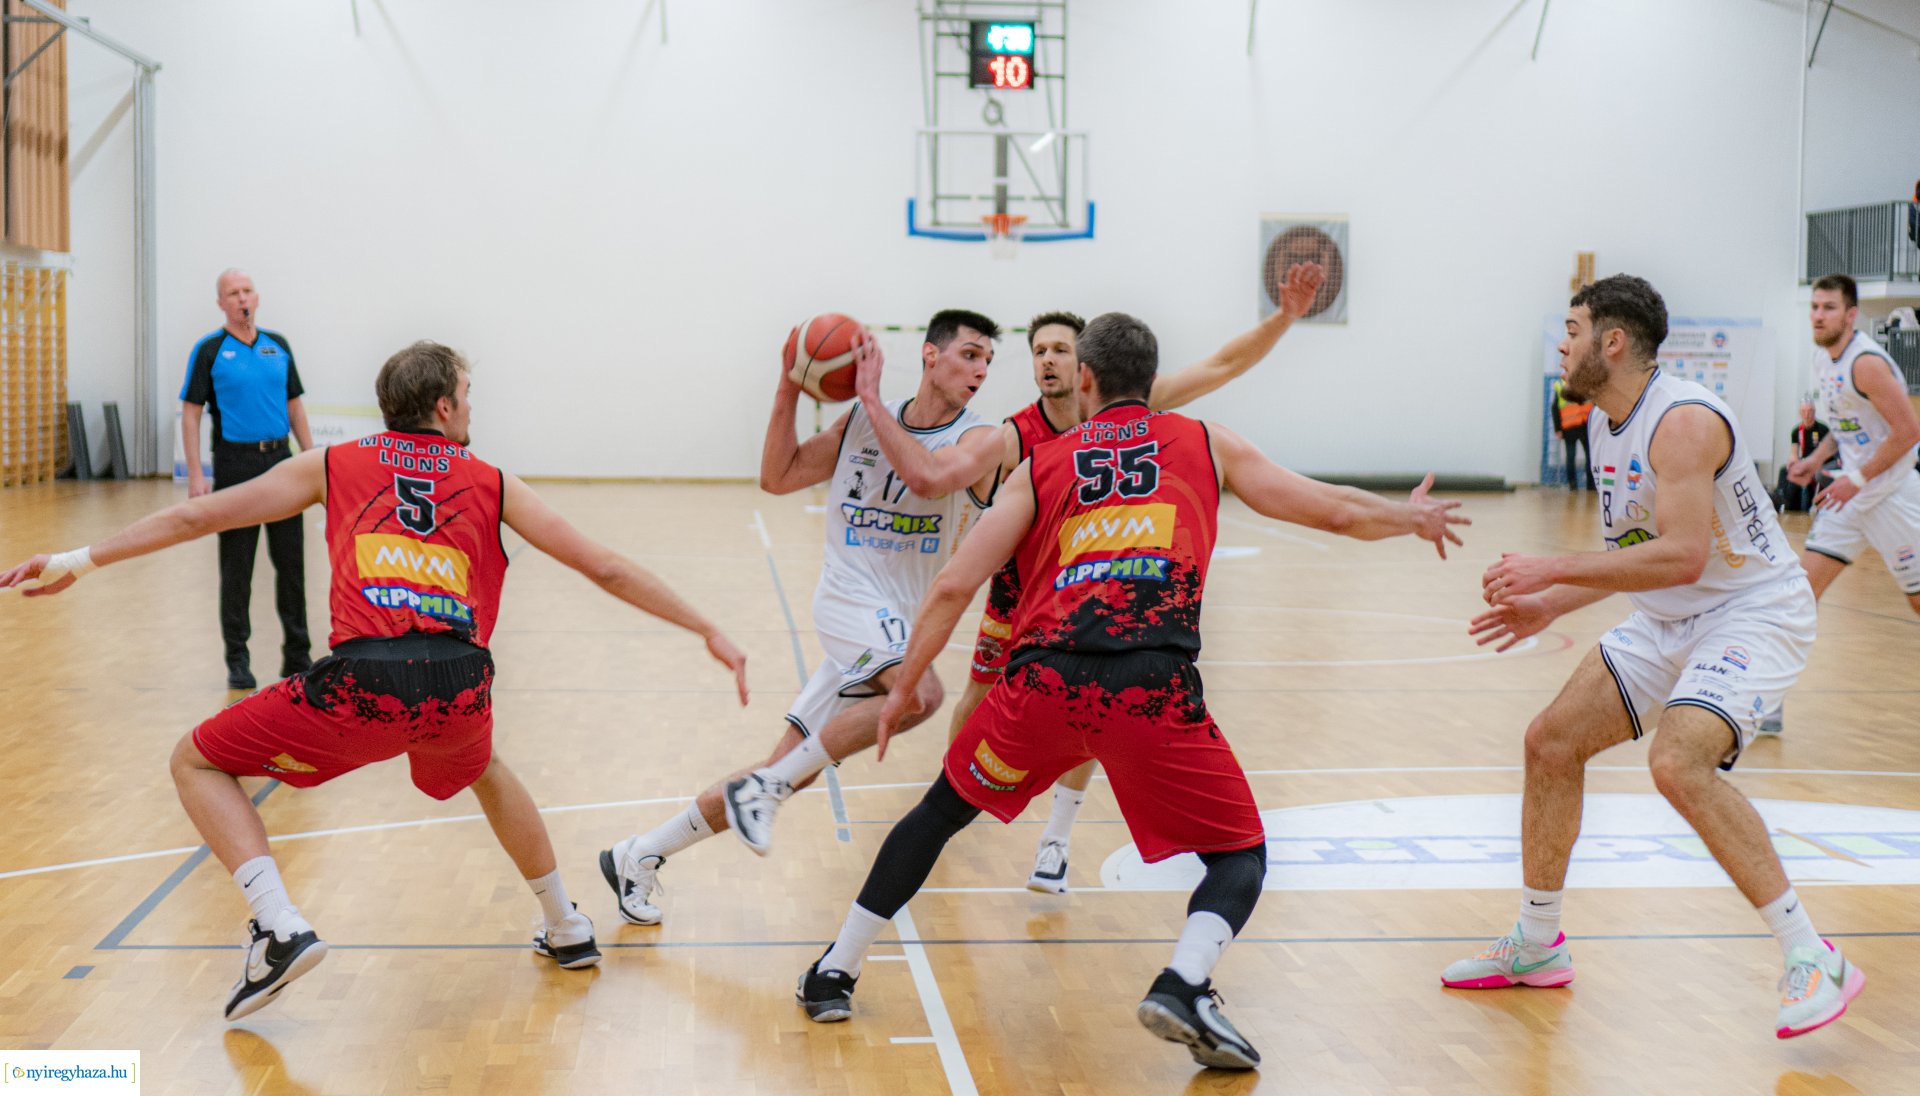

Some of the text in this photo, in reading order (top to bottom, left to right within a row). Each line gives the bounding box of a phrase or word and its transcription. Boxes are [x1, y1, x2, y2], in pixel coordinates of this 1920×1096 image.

[989, 55, 1029, 88] 10
[1081, 421, 1149, 443] LIONS
[359, 436, 470, 460] MVM-OSE
[861, 447, 880, 457] JAKO
[380, 449, 449, 473] LIONS
[1073, 441, 1160, 505] 55
[394, 473, 436, 535] 5
[1072, 516, 1155, 547] MVM
[375, 545, 455, 580] MVM
[881, 618, 906, 642] 17
[1696, 688, 1724, 702] JAKO
[981, 753, 1016, 780] MVM
